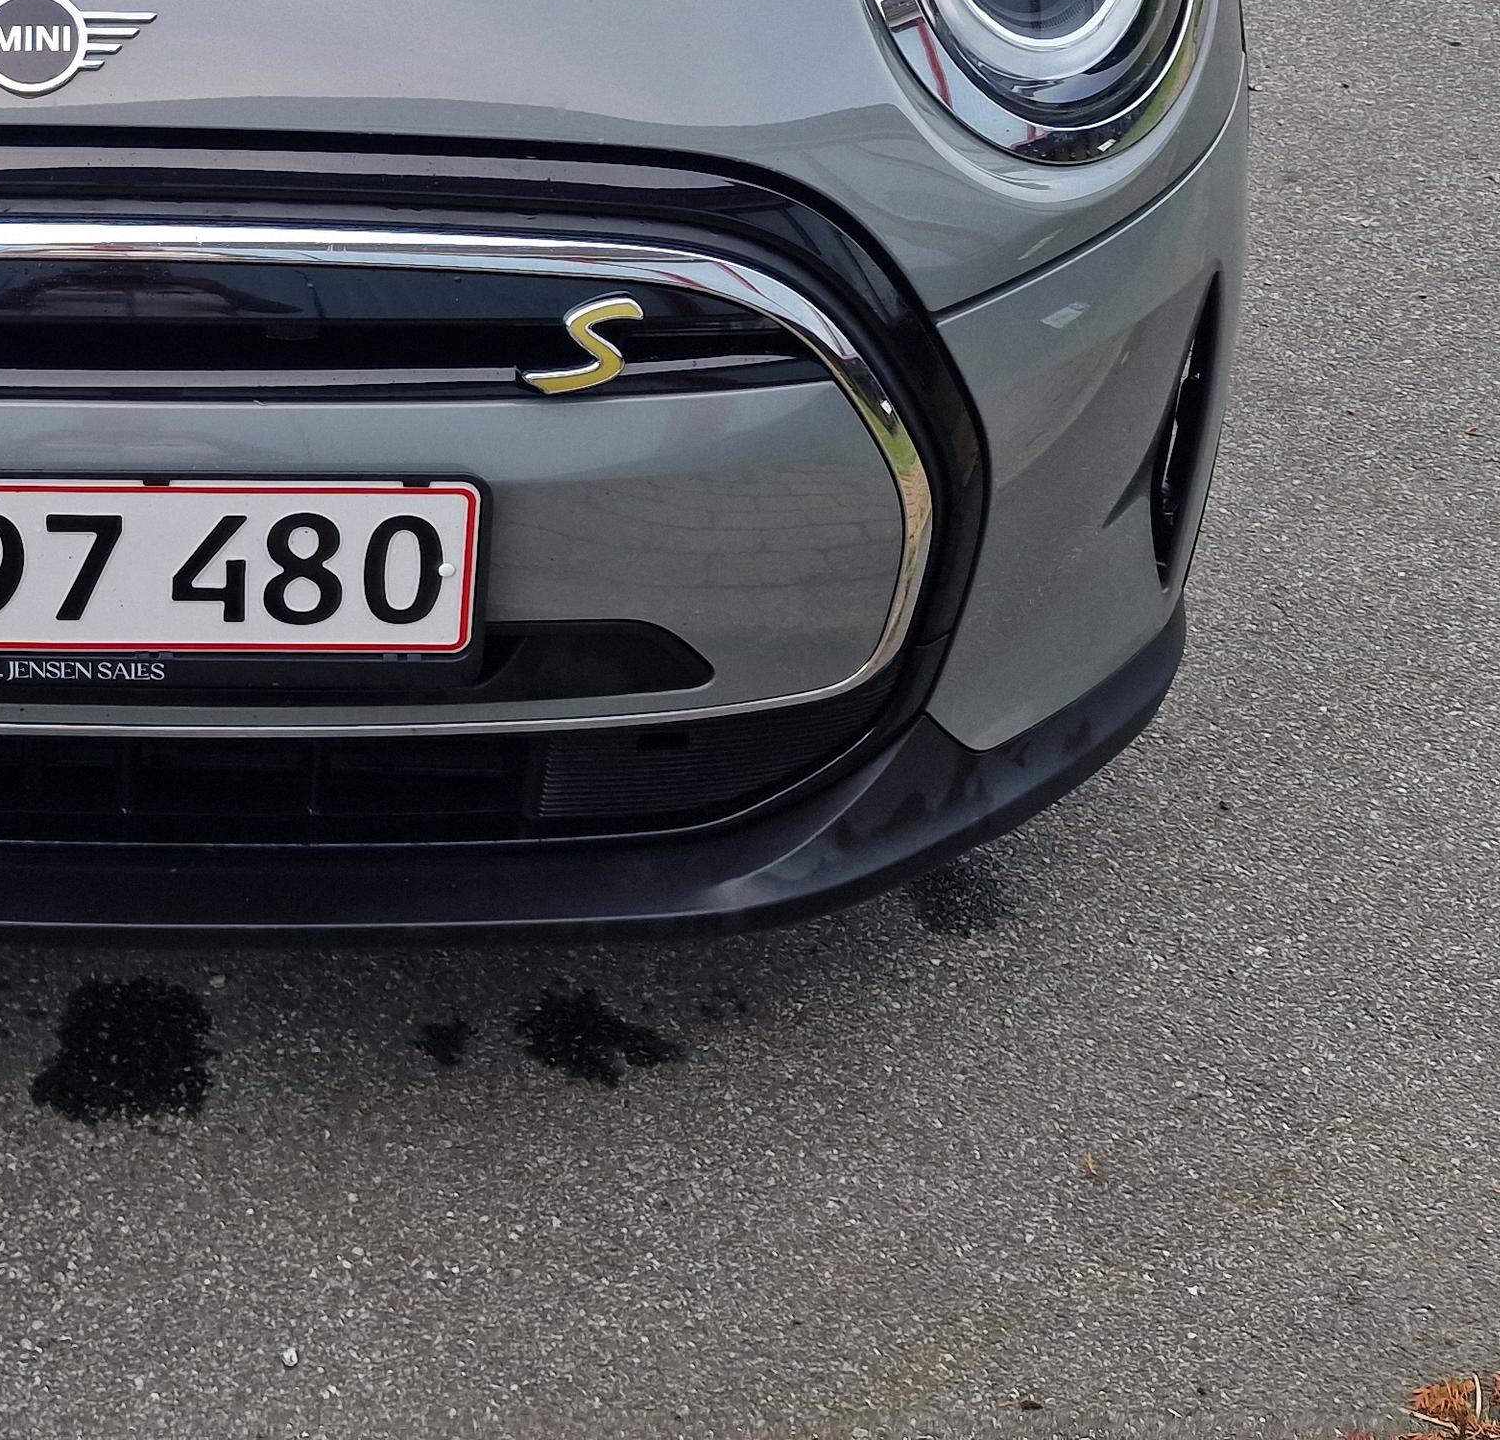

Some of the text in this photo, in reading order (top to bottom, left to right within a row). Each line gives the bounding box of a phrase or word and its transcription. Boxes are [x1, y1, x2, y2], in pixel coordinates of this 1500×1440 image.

[522, 293, 644, 395] S
[171, 512, 443, 626] 480
[7, 660, 93, 681] JENSEN
[97, 661, 166, 681] SALES
